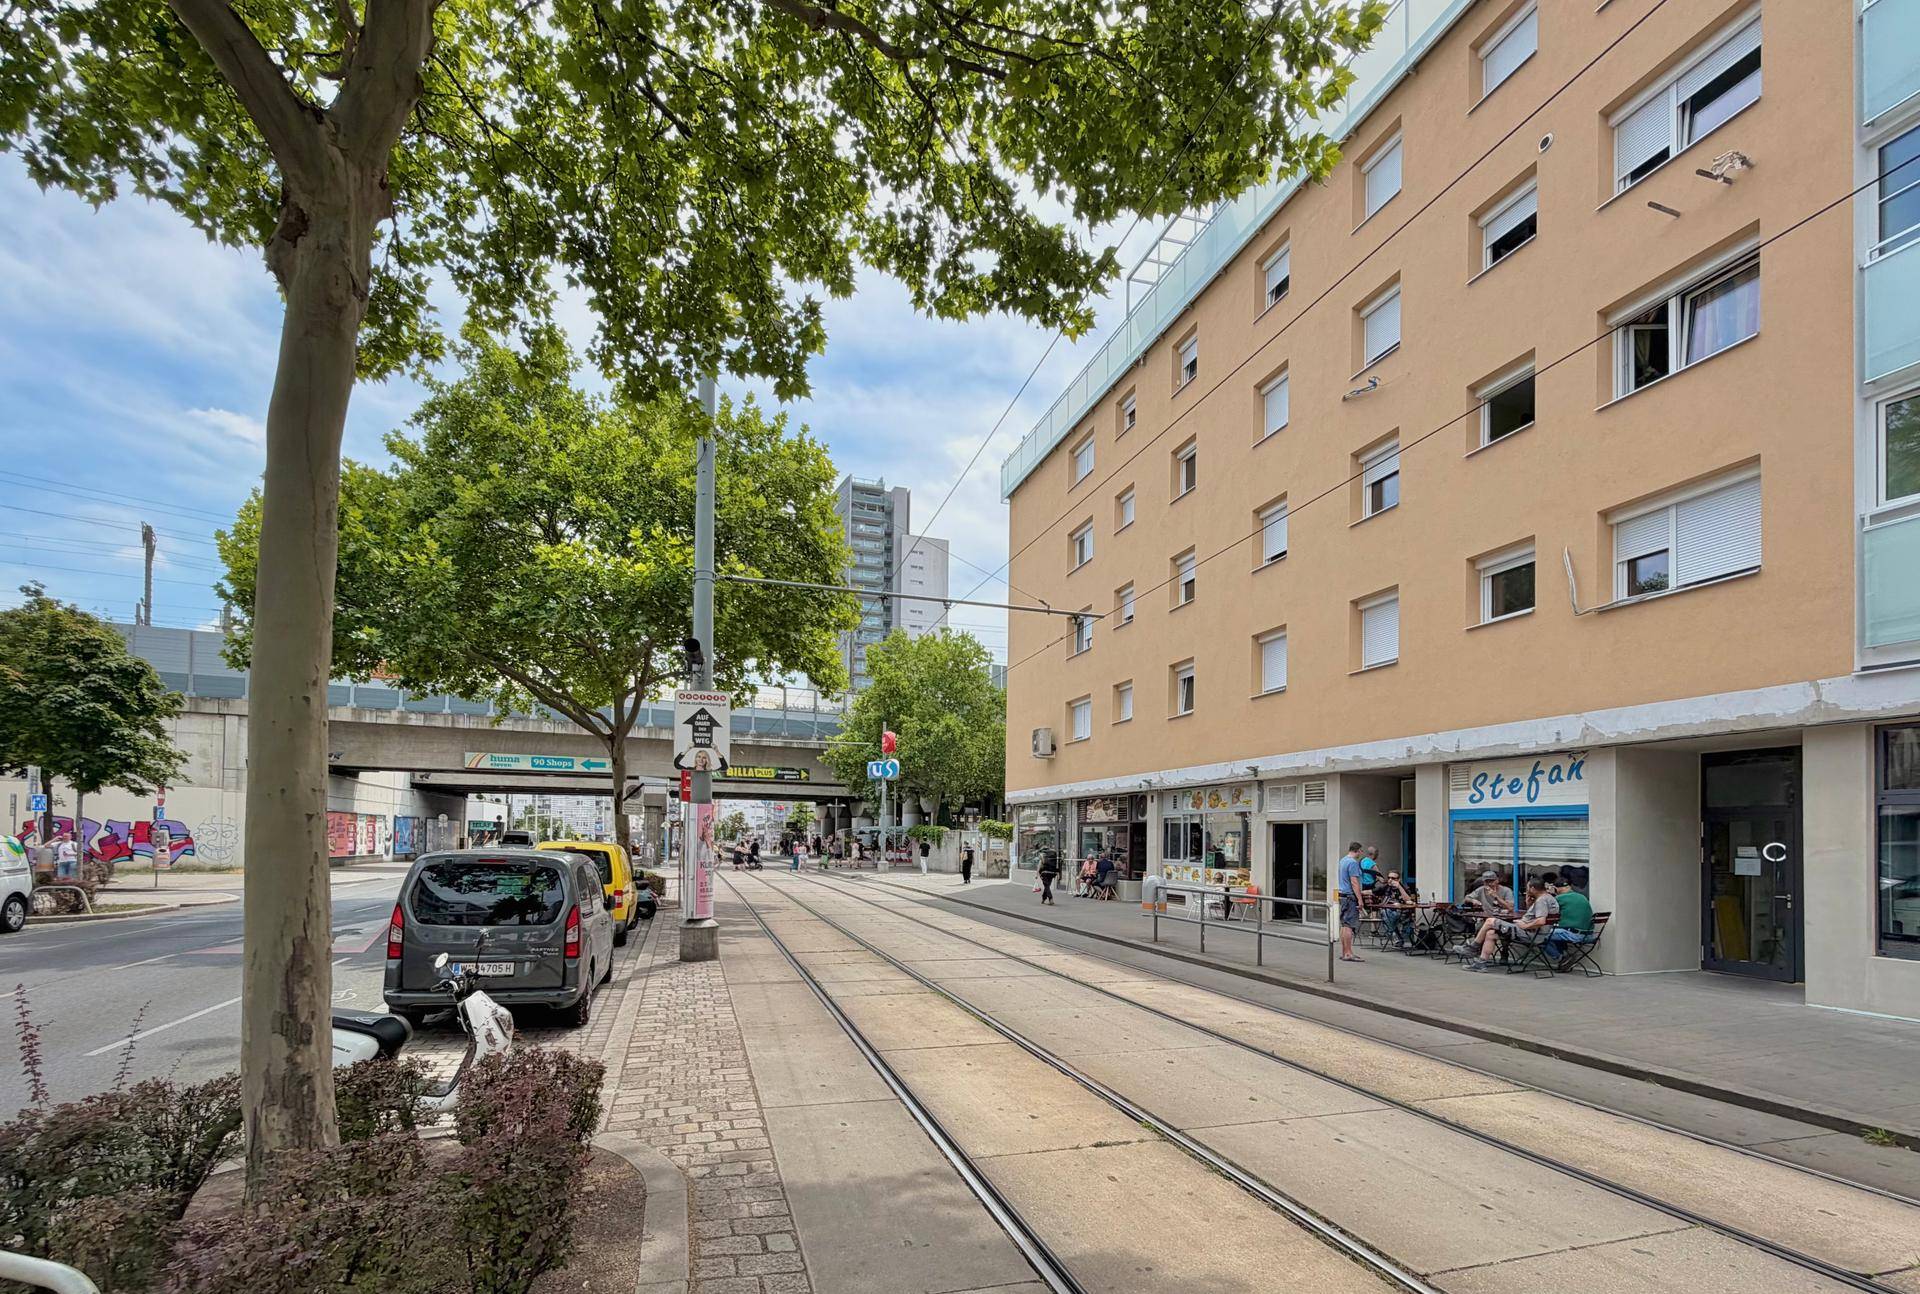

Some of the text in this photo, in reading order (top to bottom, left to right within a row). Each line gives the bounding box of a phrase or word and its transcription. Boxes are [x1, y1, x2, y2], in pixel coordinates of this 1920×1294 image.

[490, 754, 520, 763] huma
[546, 758, 573, 768] Shops
[726, 767, 754, 777] BILLA
[1468, 760, 1584, 804] Stefan
